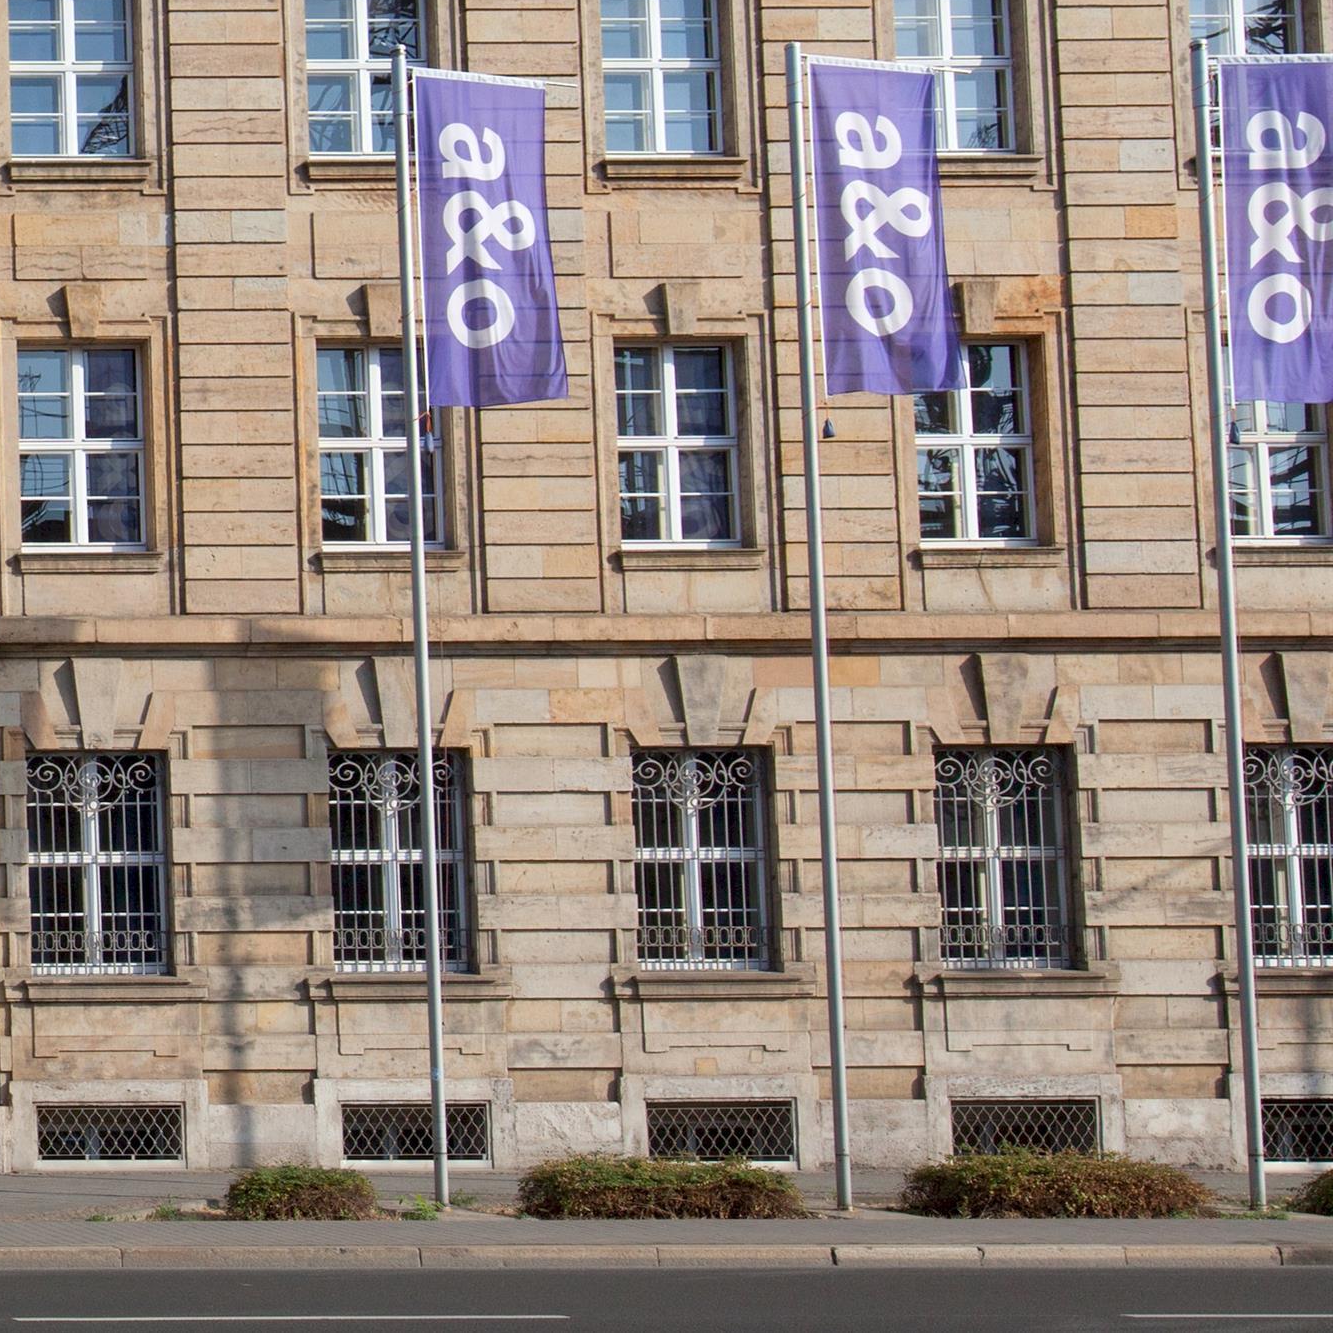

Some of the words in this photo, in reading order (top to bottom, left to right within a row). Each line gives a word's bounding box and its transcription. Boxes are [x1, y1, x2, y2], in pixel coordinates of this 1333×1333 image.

[438, 122, 535, 349] a&o
[835, 111, 932, 338] a&o
[1245, 110, 1333, 344] a&o
